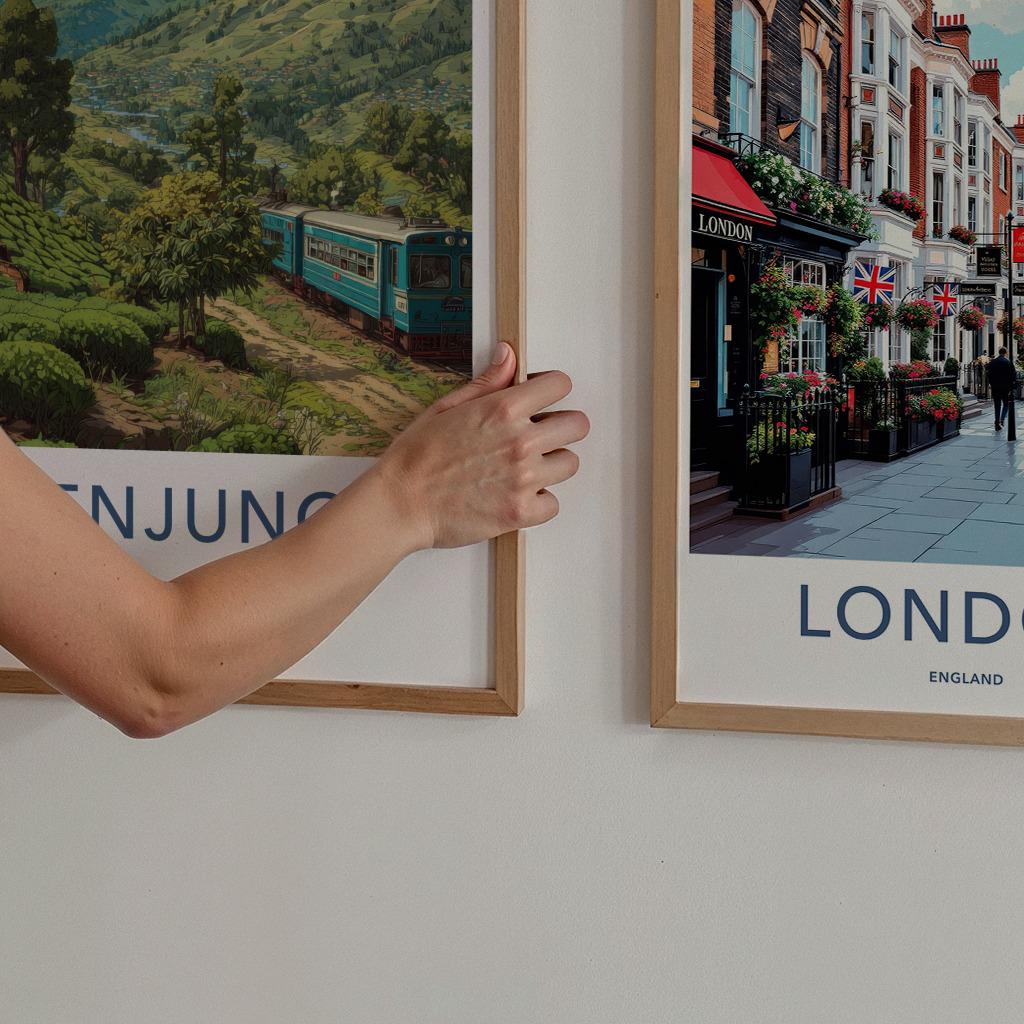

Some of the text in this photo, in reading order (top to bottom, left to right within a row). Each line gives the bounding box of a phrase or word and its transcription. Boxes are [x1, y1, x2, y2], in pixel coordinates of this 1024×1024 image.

[698, 213, 753, 242] LONDON
[800, 584, 1024, 645] LOND
[929, 671, 1004, 686] ENGLAND
